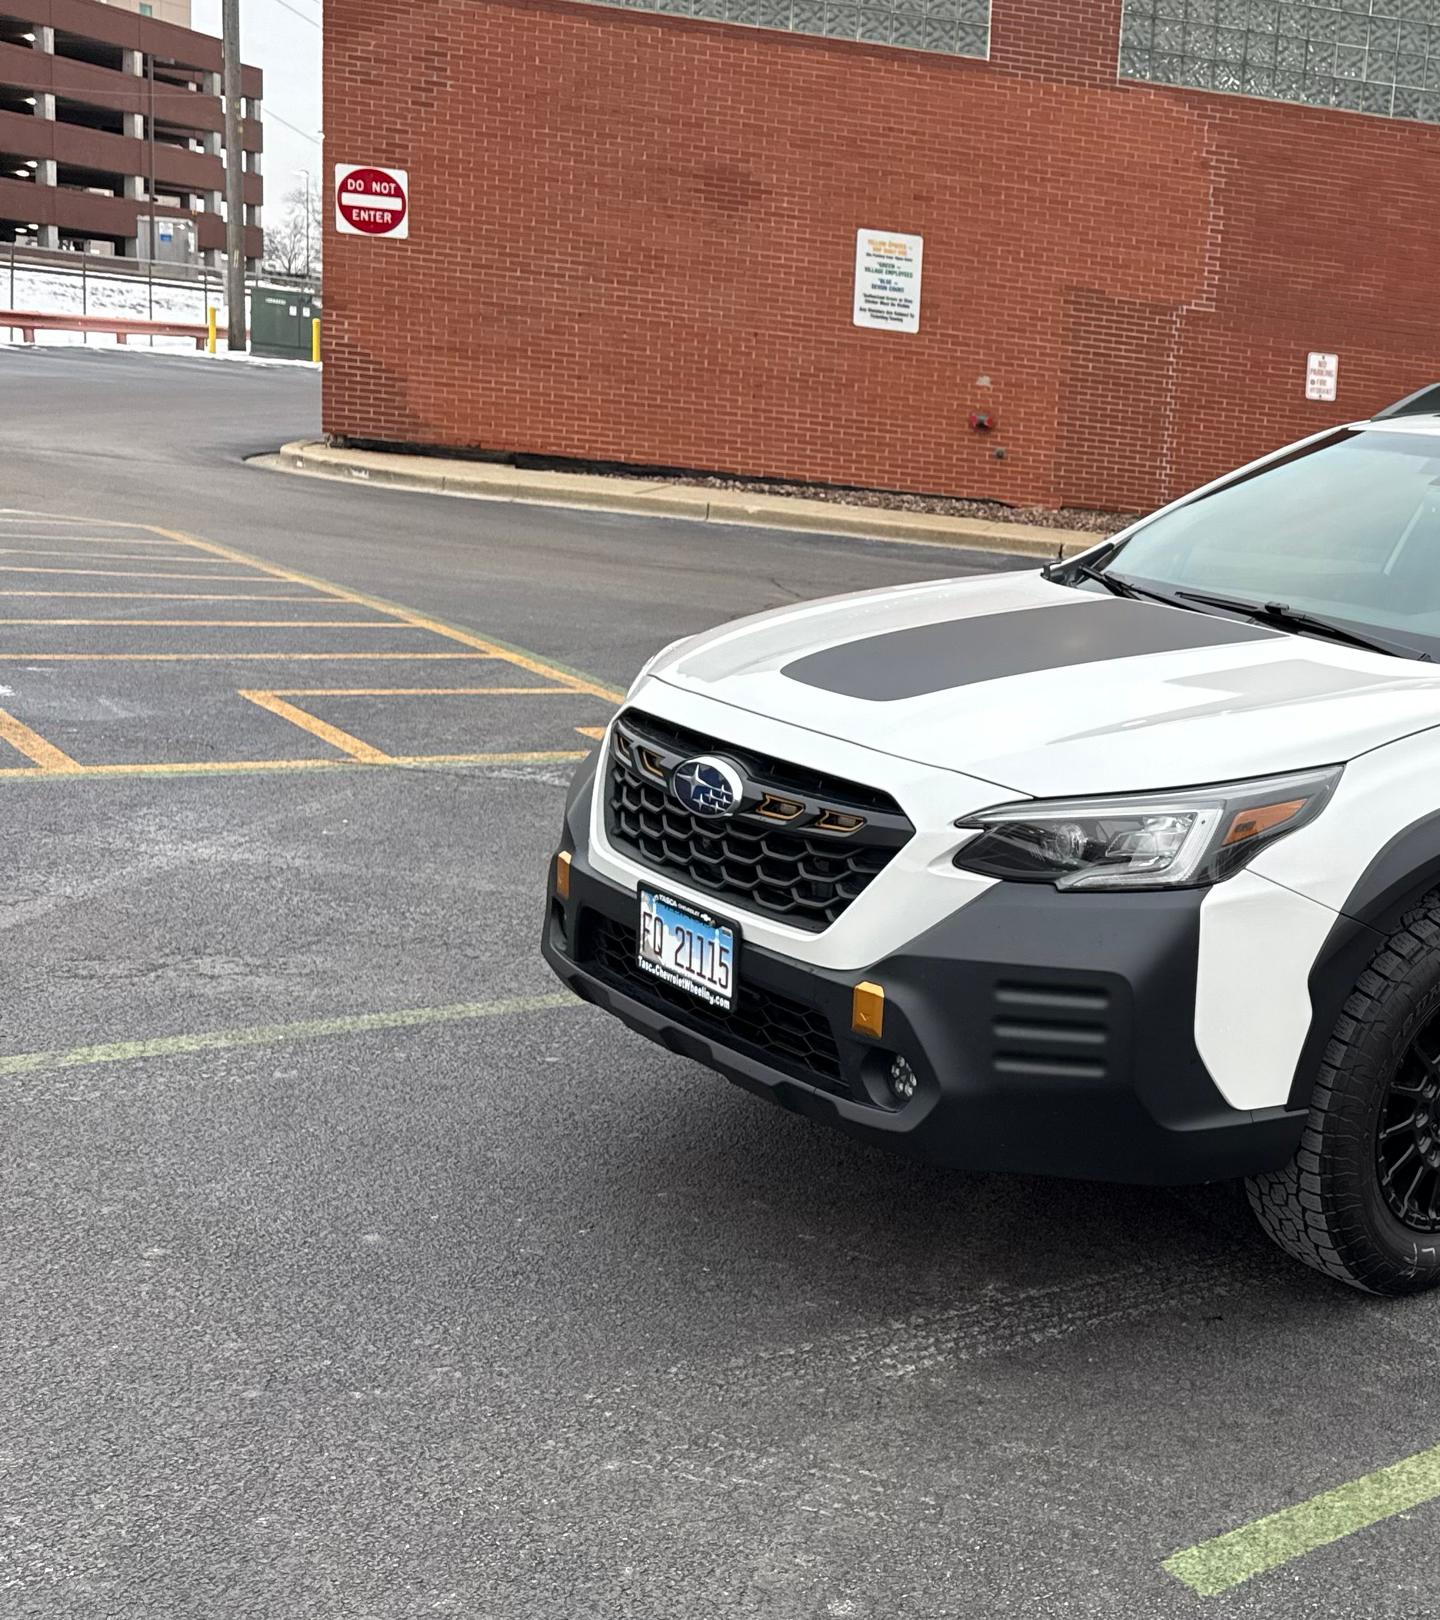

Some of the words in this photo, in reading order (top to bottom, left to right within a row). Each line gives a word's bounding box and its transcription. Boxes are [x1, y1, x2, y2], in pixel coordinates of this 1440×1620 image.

[347, 179, 364, 191] DO
[372, 182, 396, 194] NOT
[352, 209, 392, 224] ENTER
[659, 894, 677, 907] TASCA
[642, 912, 664, 957] FQ
[674, 926, 730, 990] 21115
